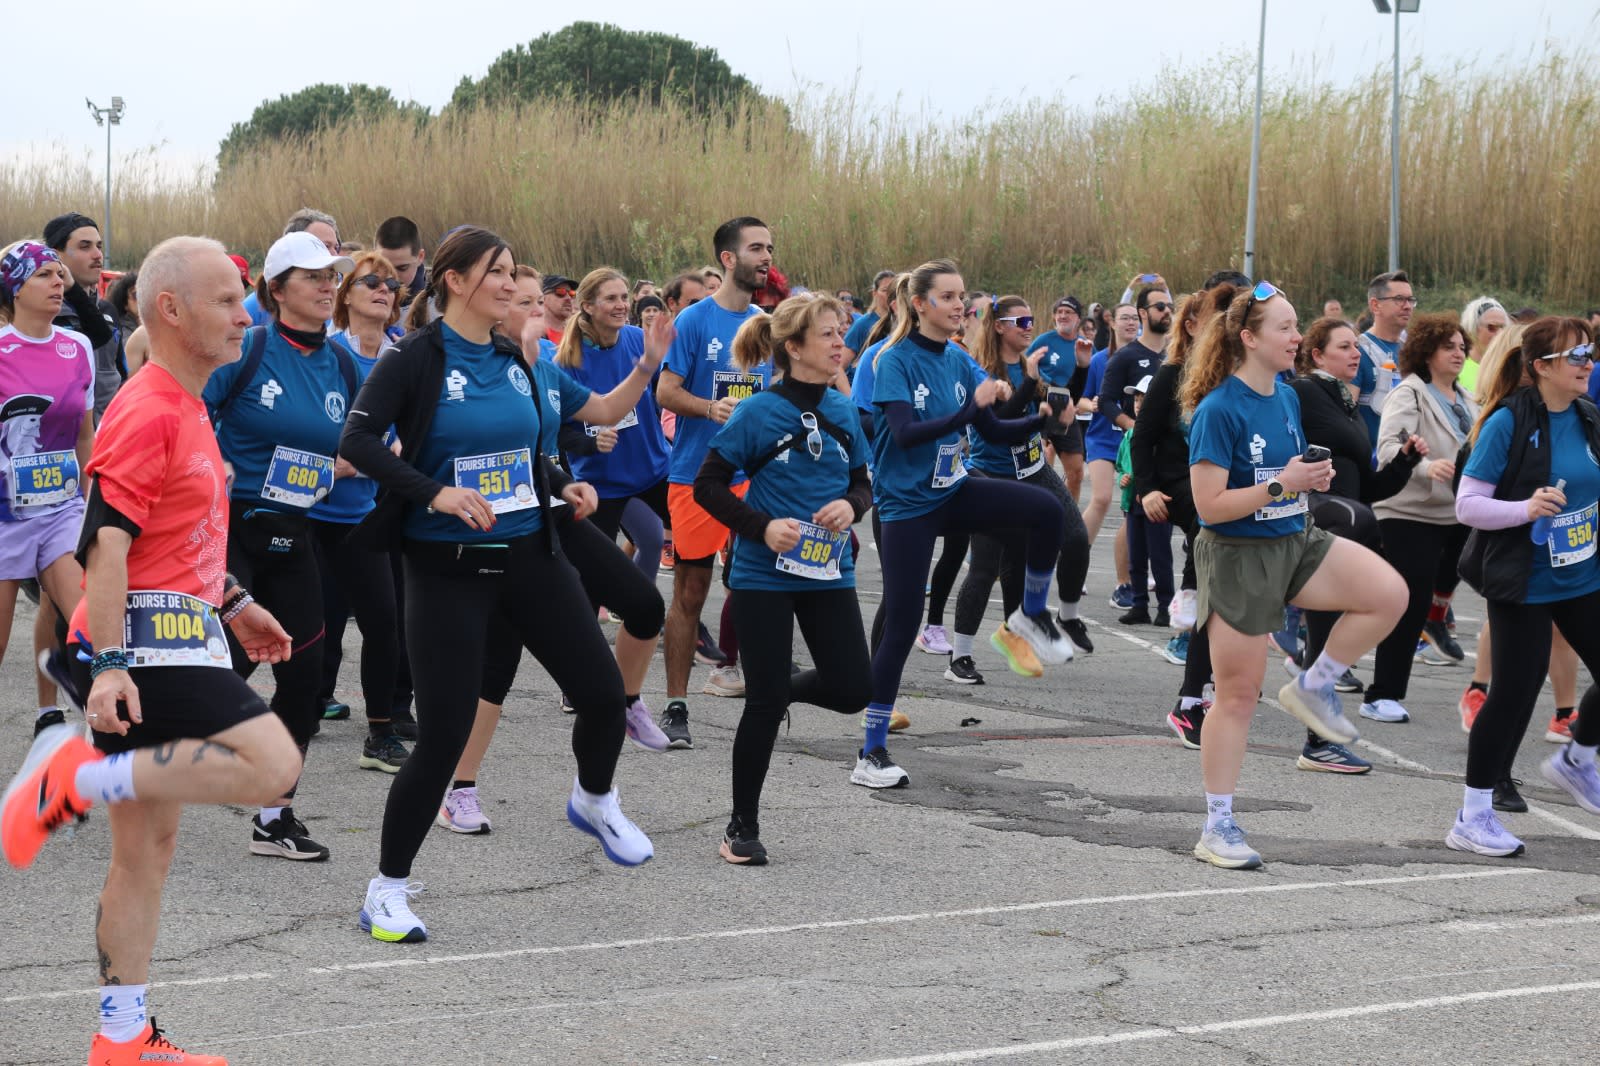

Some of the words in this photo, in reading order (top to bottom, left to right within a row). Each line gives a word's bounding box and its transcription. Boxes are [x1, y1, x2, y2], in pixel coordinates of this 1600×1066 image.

[715, 373, 736, 382] COURSE
[736, 374, 743, 382] DE
[728, 384, 753, 400] 1086
[13, 456, 39, 468] COURSE
[39, 455, 48, 465] DE
[275, 448, 301, 463] COURSE
[301, 454, 309, 465] DE
[457, 457, 485, 472] COURSE
[487, 456, 496, 468] DE
[32, 466, 63, 489] 525
[287, 465, 319, 489] 680
[479, 469, 510, 496] 551
[1257, 470, 1281, 481] COURS
[1552, 516, 1574, 528] OURSE
[1574, 514, 1582, 524] DE
[799, 523, 816, 537] URSE
[816, 528, 826, 540] DE
[1567, 521, 1592, 548] 558
[271, 536, 293, 547] ROC
[800, 539, 832, 564] 589
[168, 594, 181, 609] DE
[151, 612, 205, 641] 1004
